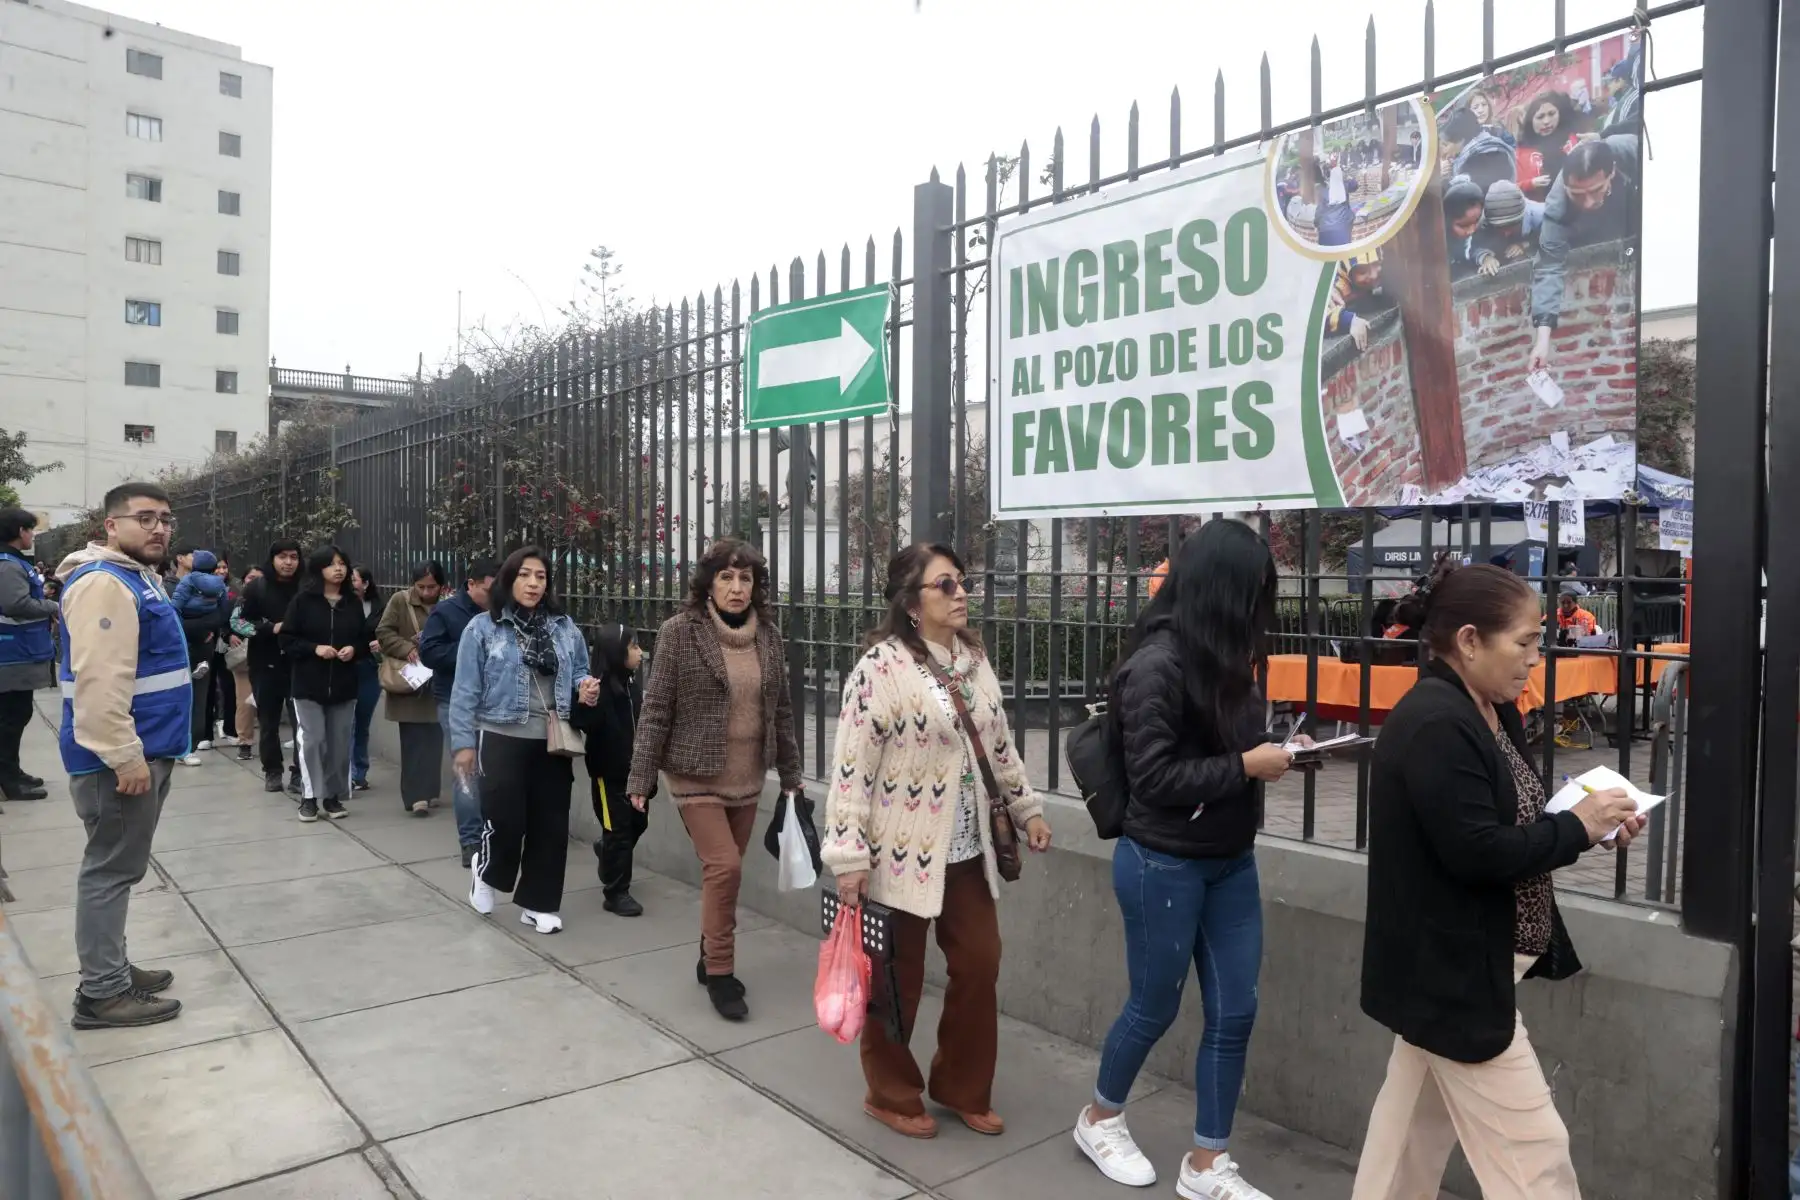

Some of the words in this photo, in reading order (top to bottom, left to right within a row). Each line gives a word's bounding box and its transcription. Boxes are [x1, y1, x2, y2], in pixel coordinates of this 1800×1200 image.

[1009, 206, 1269, 340] INGRESO
[1011, 354, 1045, 397] AL
[1054, 337, 1139, 391] POZO
[1149, 327, 1198, 377] DE
[1208, 312, 1284, 370] LOS
[1012, 380, 1275, 477] FAVORES
[1384, 551, 1407, 562] DIRIS
